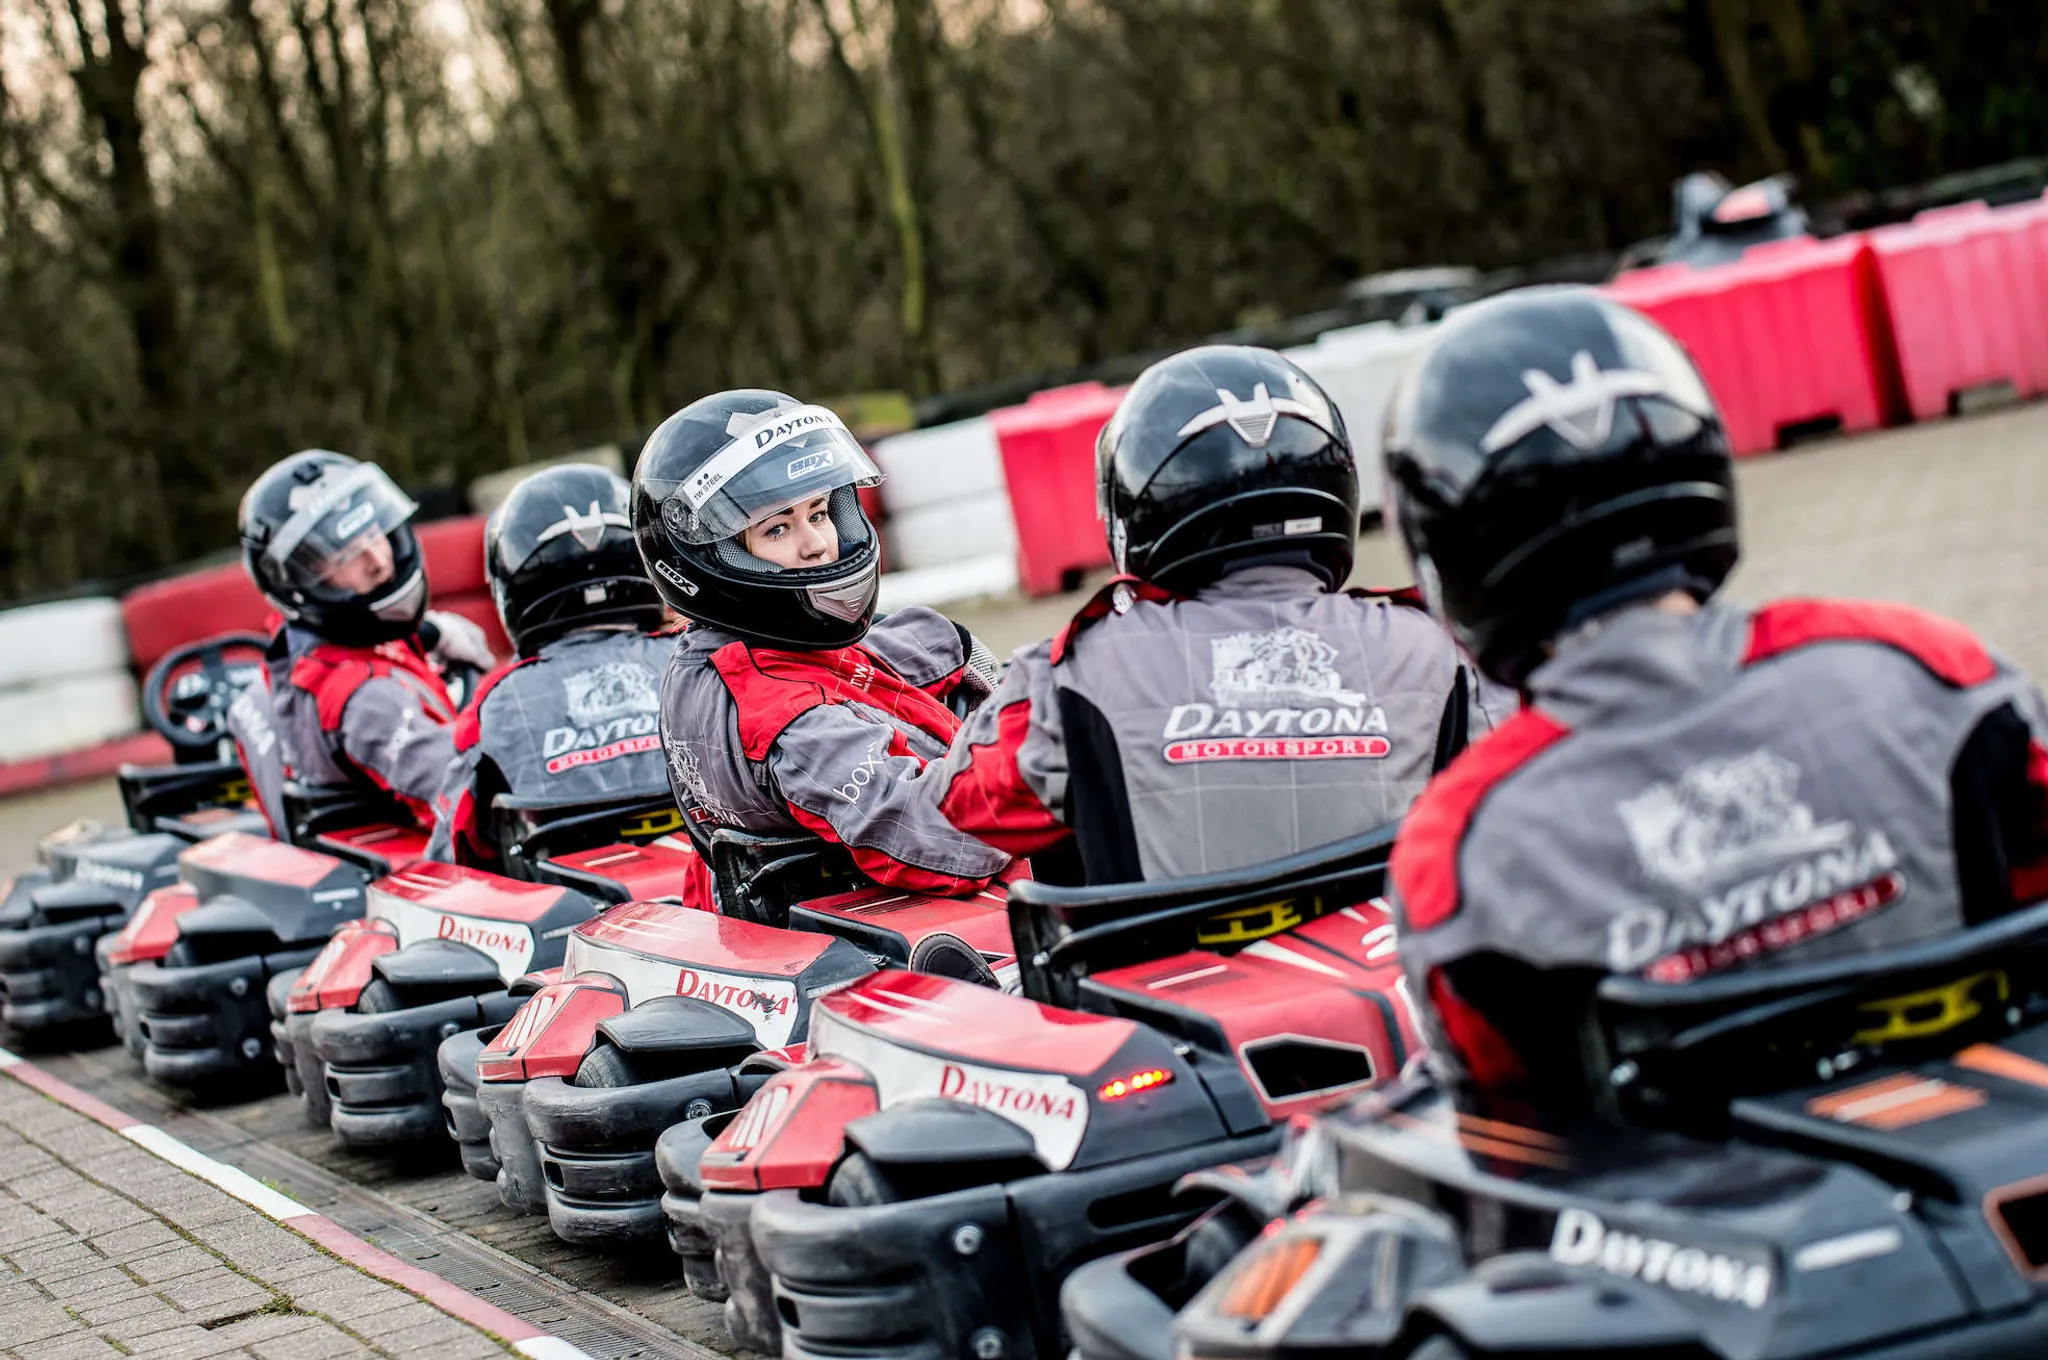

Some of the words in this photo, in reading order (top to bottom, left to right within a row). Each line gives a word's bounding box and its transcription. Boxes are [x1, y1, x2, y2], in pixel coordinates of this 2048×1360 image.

[755, 415, 833, 448] DAYTONA
[701, 471, 723, 492] STEEL
[850, 662, 869, 687] TW
[543, 713, 660, 758] DAYTO
[1163, 703, 1388, 738] DAYTONA
[1181, 740, 1373, 758] MOTORSPORT
[1606, 830, 1897, 973] DAYTONA
[438, 915, 527, 953] DAYTONA
[940, 1065, 1075, 1119] DAYTONA
